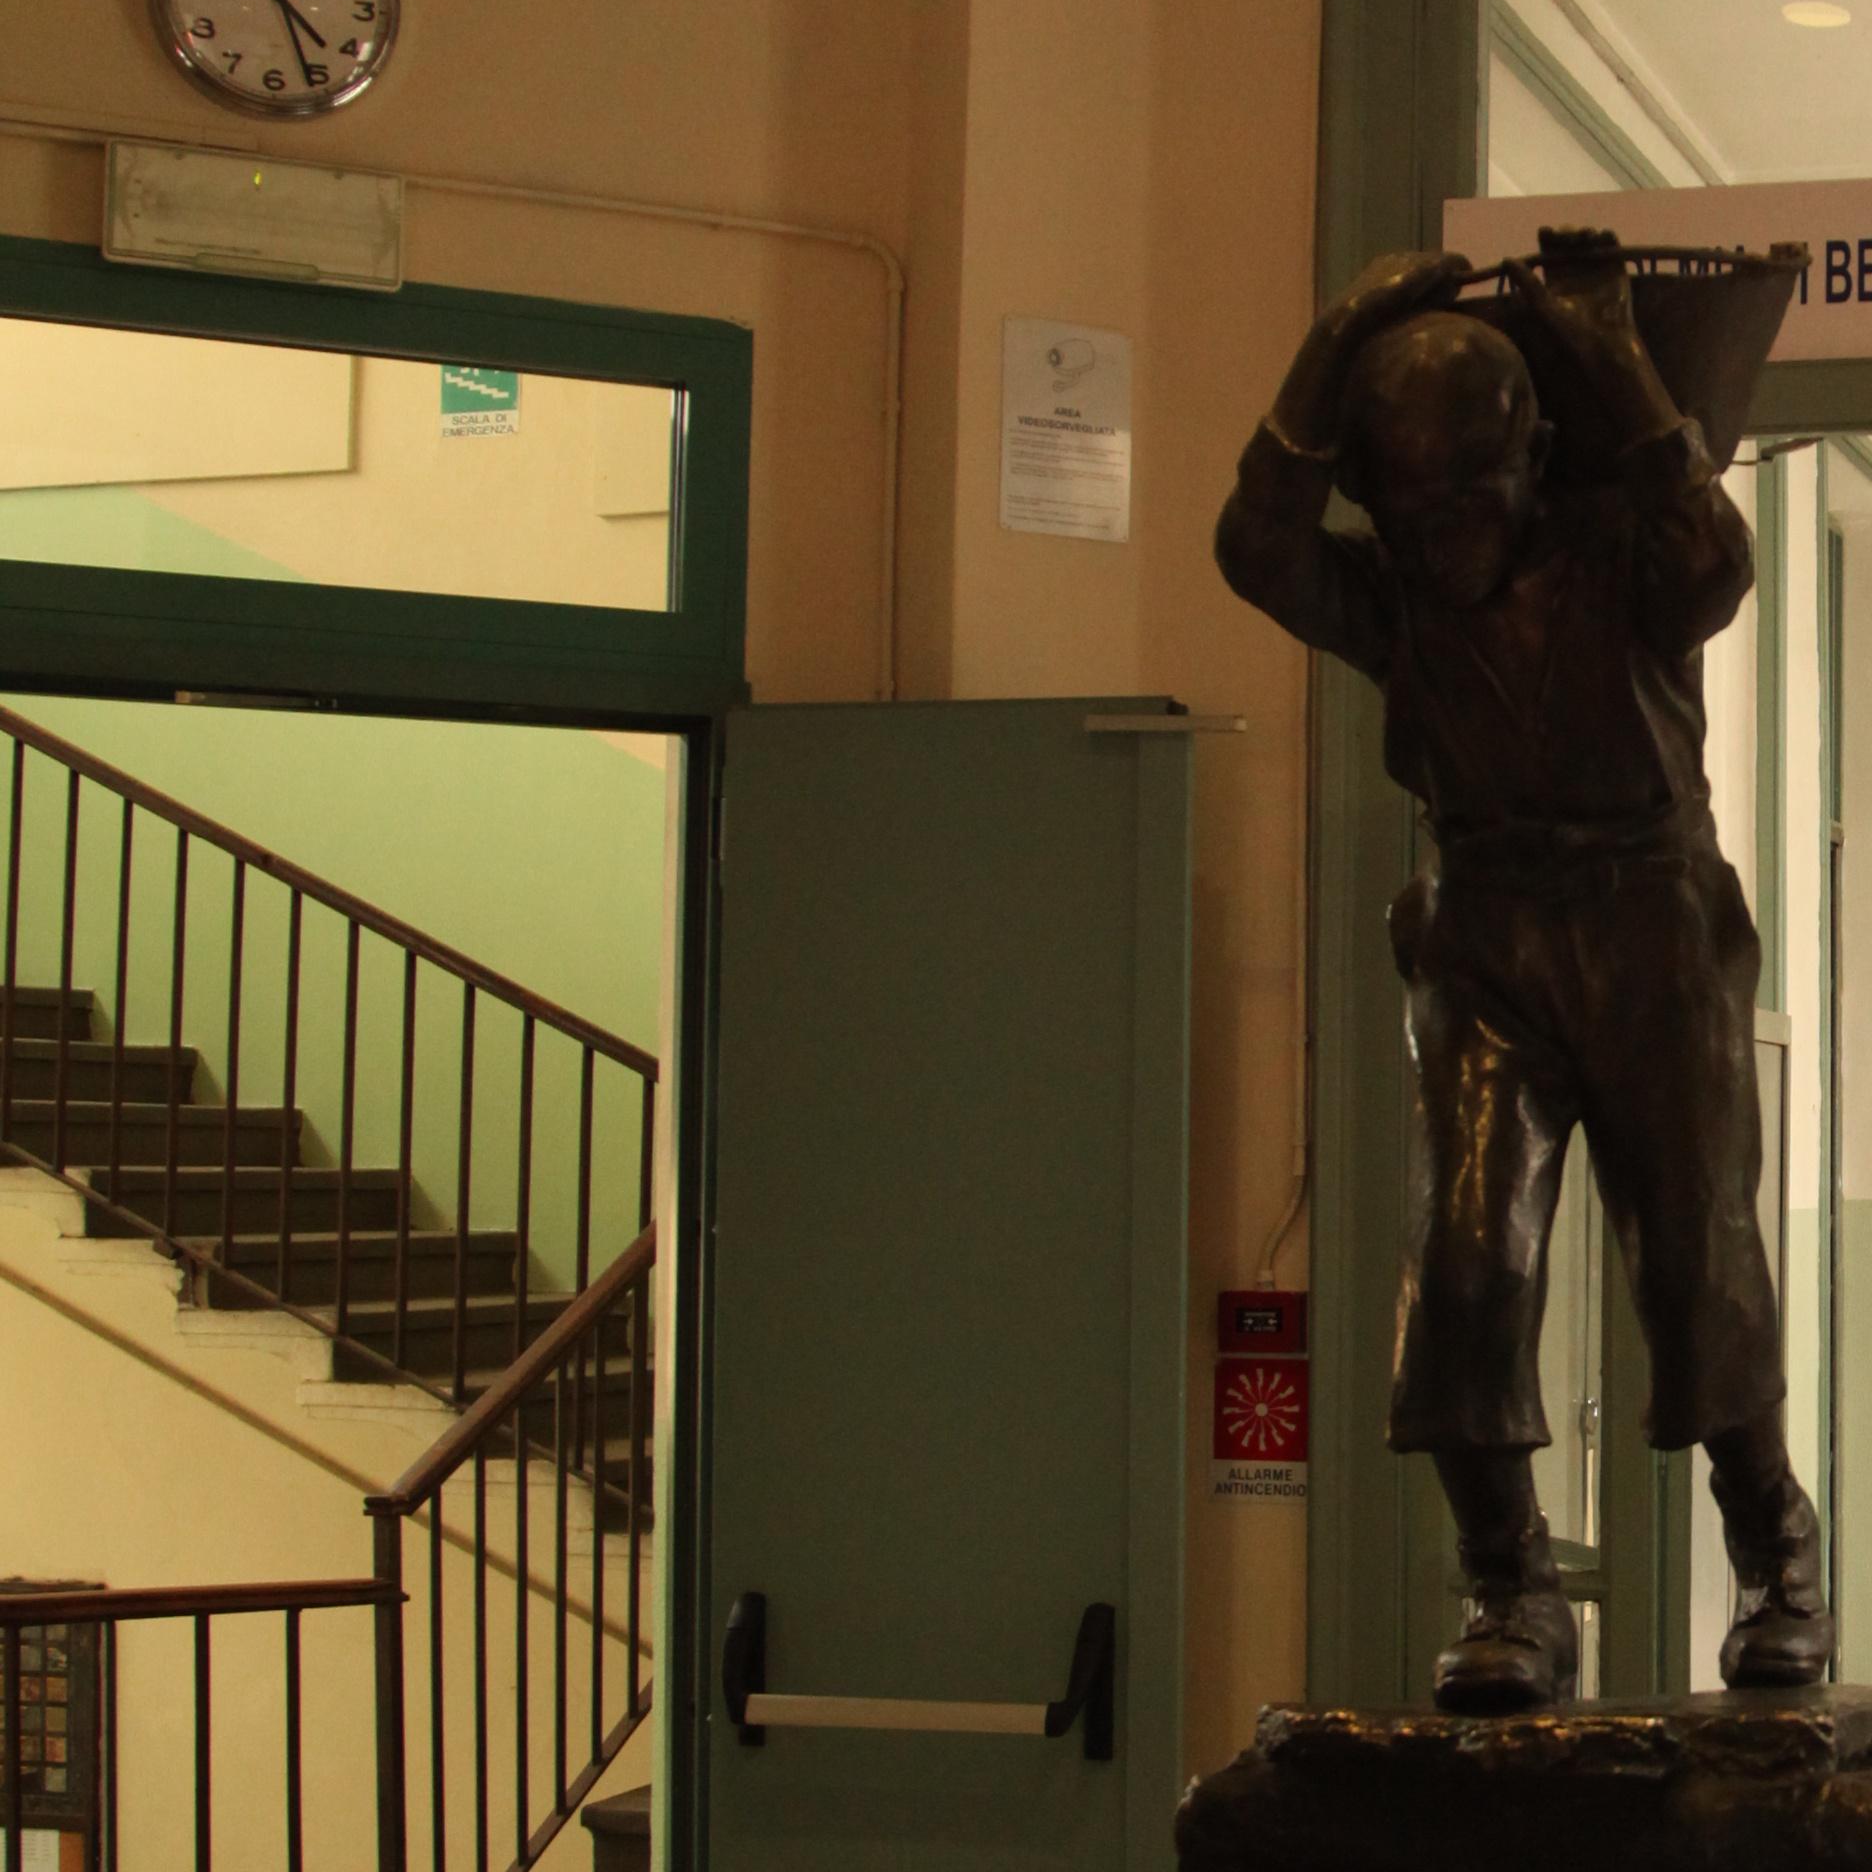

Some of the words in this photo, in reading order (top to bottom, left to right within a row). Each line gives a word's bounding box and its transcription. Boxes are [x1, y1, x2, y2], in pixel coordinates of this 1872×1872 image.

[353, 0, 375, 22] 3
[339, 37, 360, 58] 4
[222, 50, 243, 74] 7
[262, 69, 286, 91] 6
[451, 414, 490, 426] SCALA
[495, 413, 507, 423] DI
[442, 424, 515, 438] EMERGENZA
[1228, 1468, 1293, 1482] ALLARME
[1214, 1481, 1307, 1497] ANTINCENDIO
